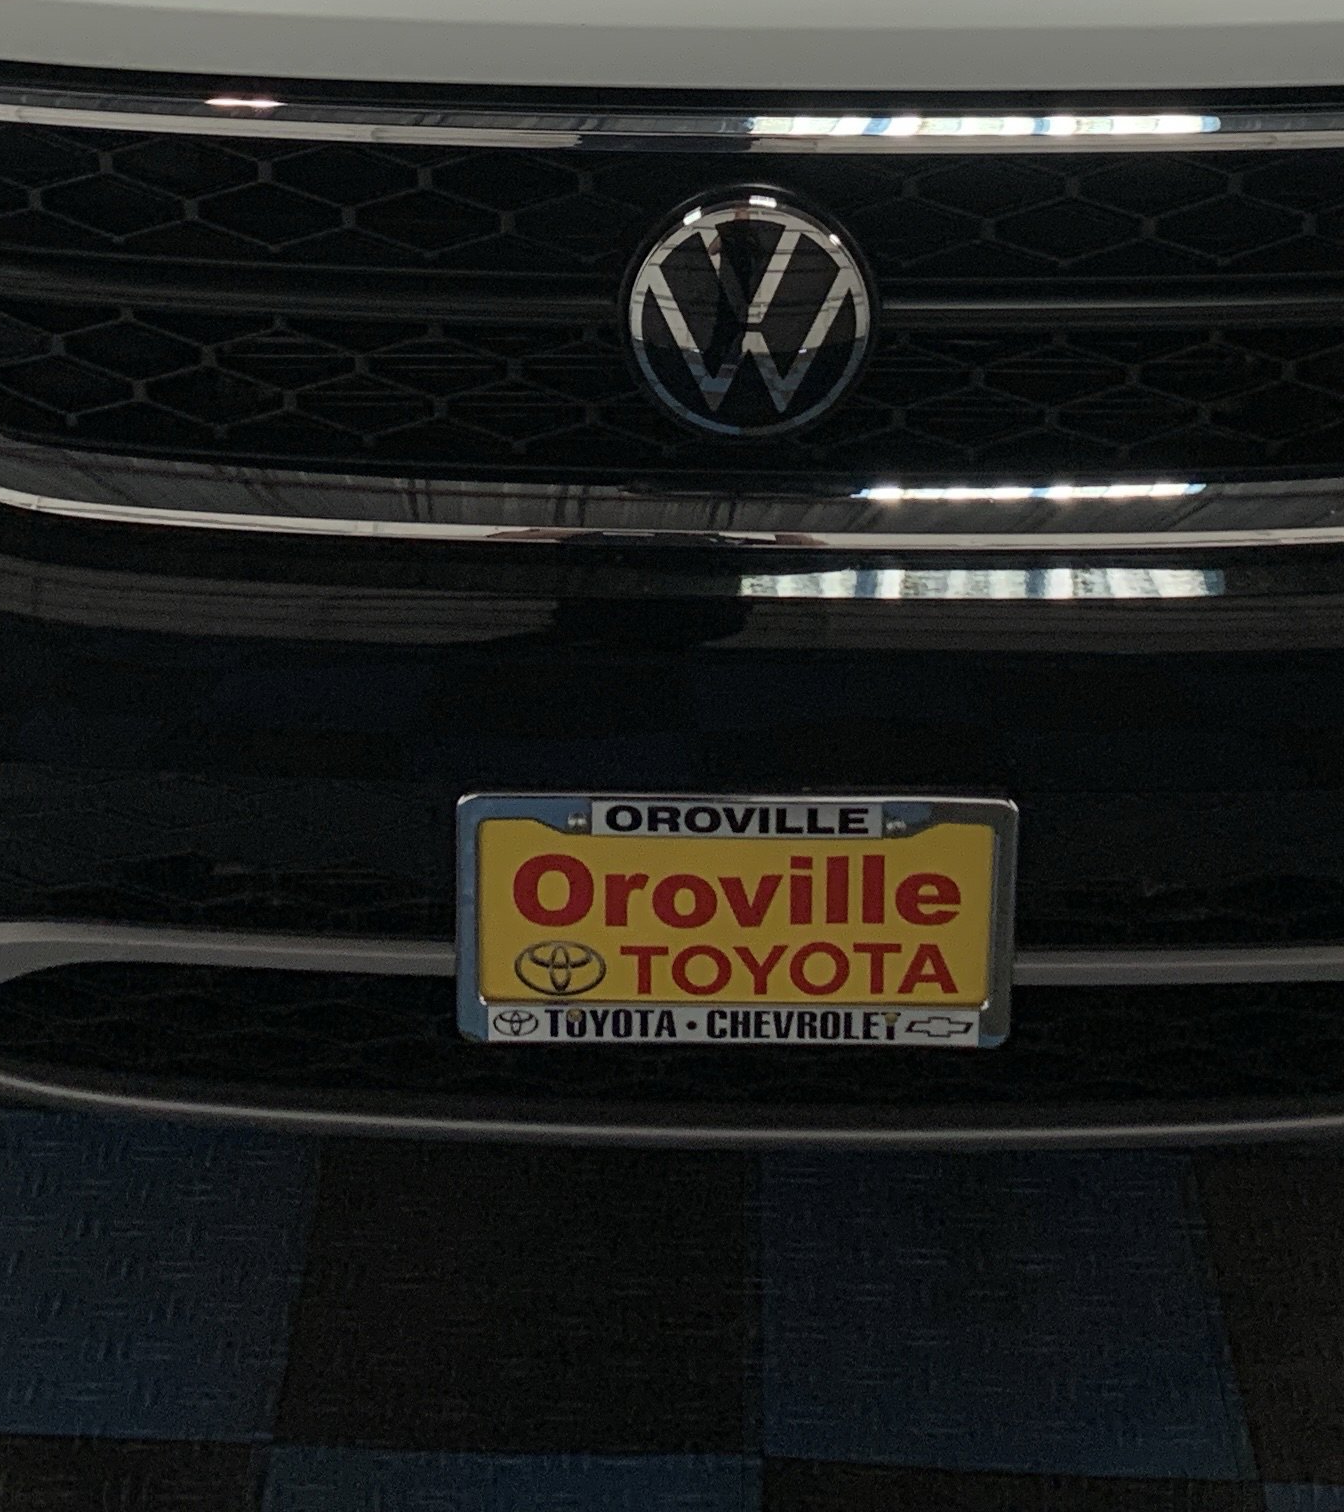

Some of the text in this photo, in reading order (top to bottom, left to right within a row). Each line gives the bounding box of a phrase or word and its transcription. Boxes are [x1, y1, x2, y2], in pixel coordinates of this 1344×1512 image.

[604, 805, 870, 835] OROVILLE
[512, 853, 962, 929] Oroville
[620, 941, 960, 996] TOYOTA
[544, 1008, 902, 1041] TOYOTA CHEVROLET
